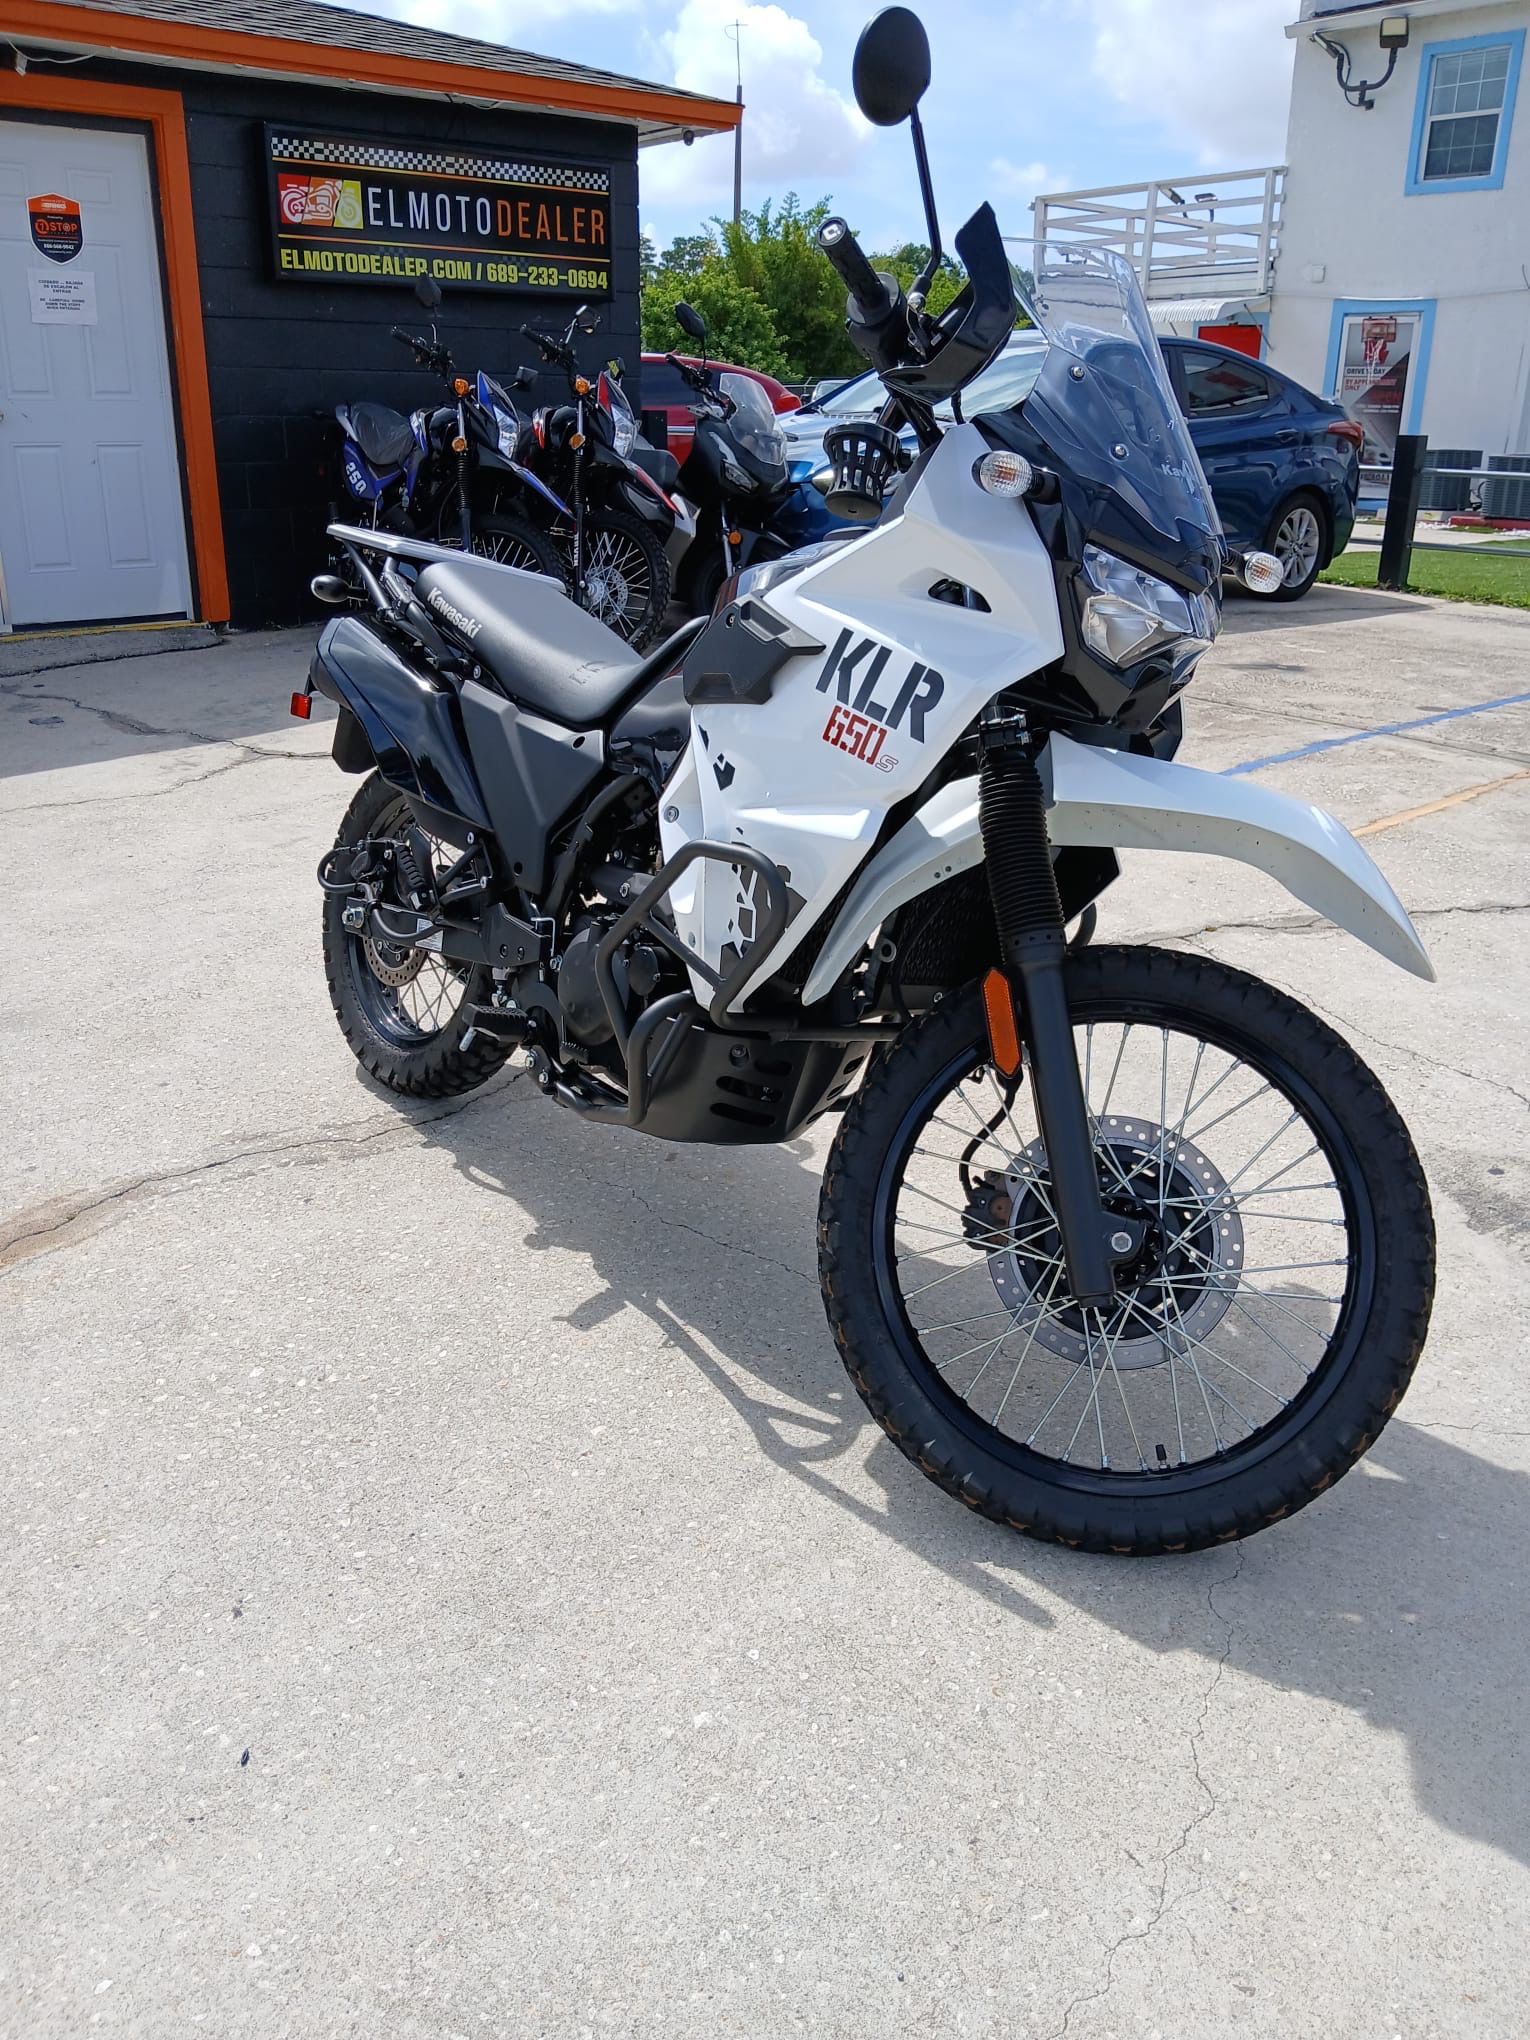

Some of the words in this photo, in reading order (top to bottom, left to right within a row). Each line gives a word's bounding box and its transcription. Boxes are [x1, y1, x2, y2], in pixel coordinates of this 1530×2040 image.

[367, 186, 606, 245] ELMOTODEALER
[280, 248, 472, 281] ELMOTODEALER.COM
[486, 263, 609, 290] 689-233-0694
[345, 461, 368, 496] 250
[426, 586, 484, 640] Kawasaki
[815, 626, 945, 744] KLR
